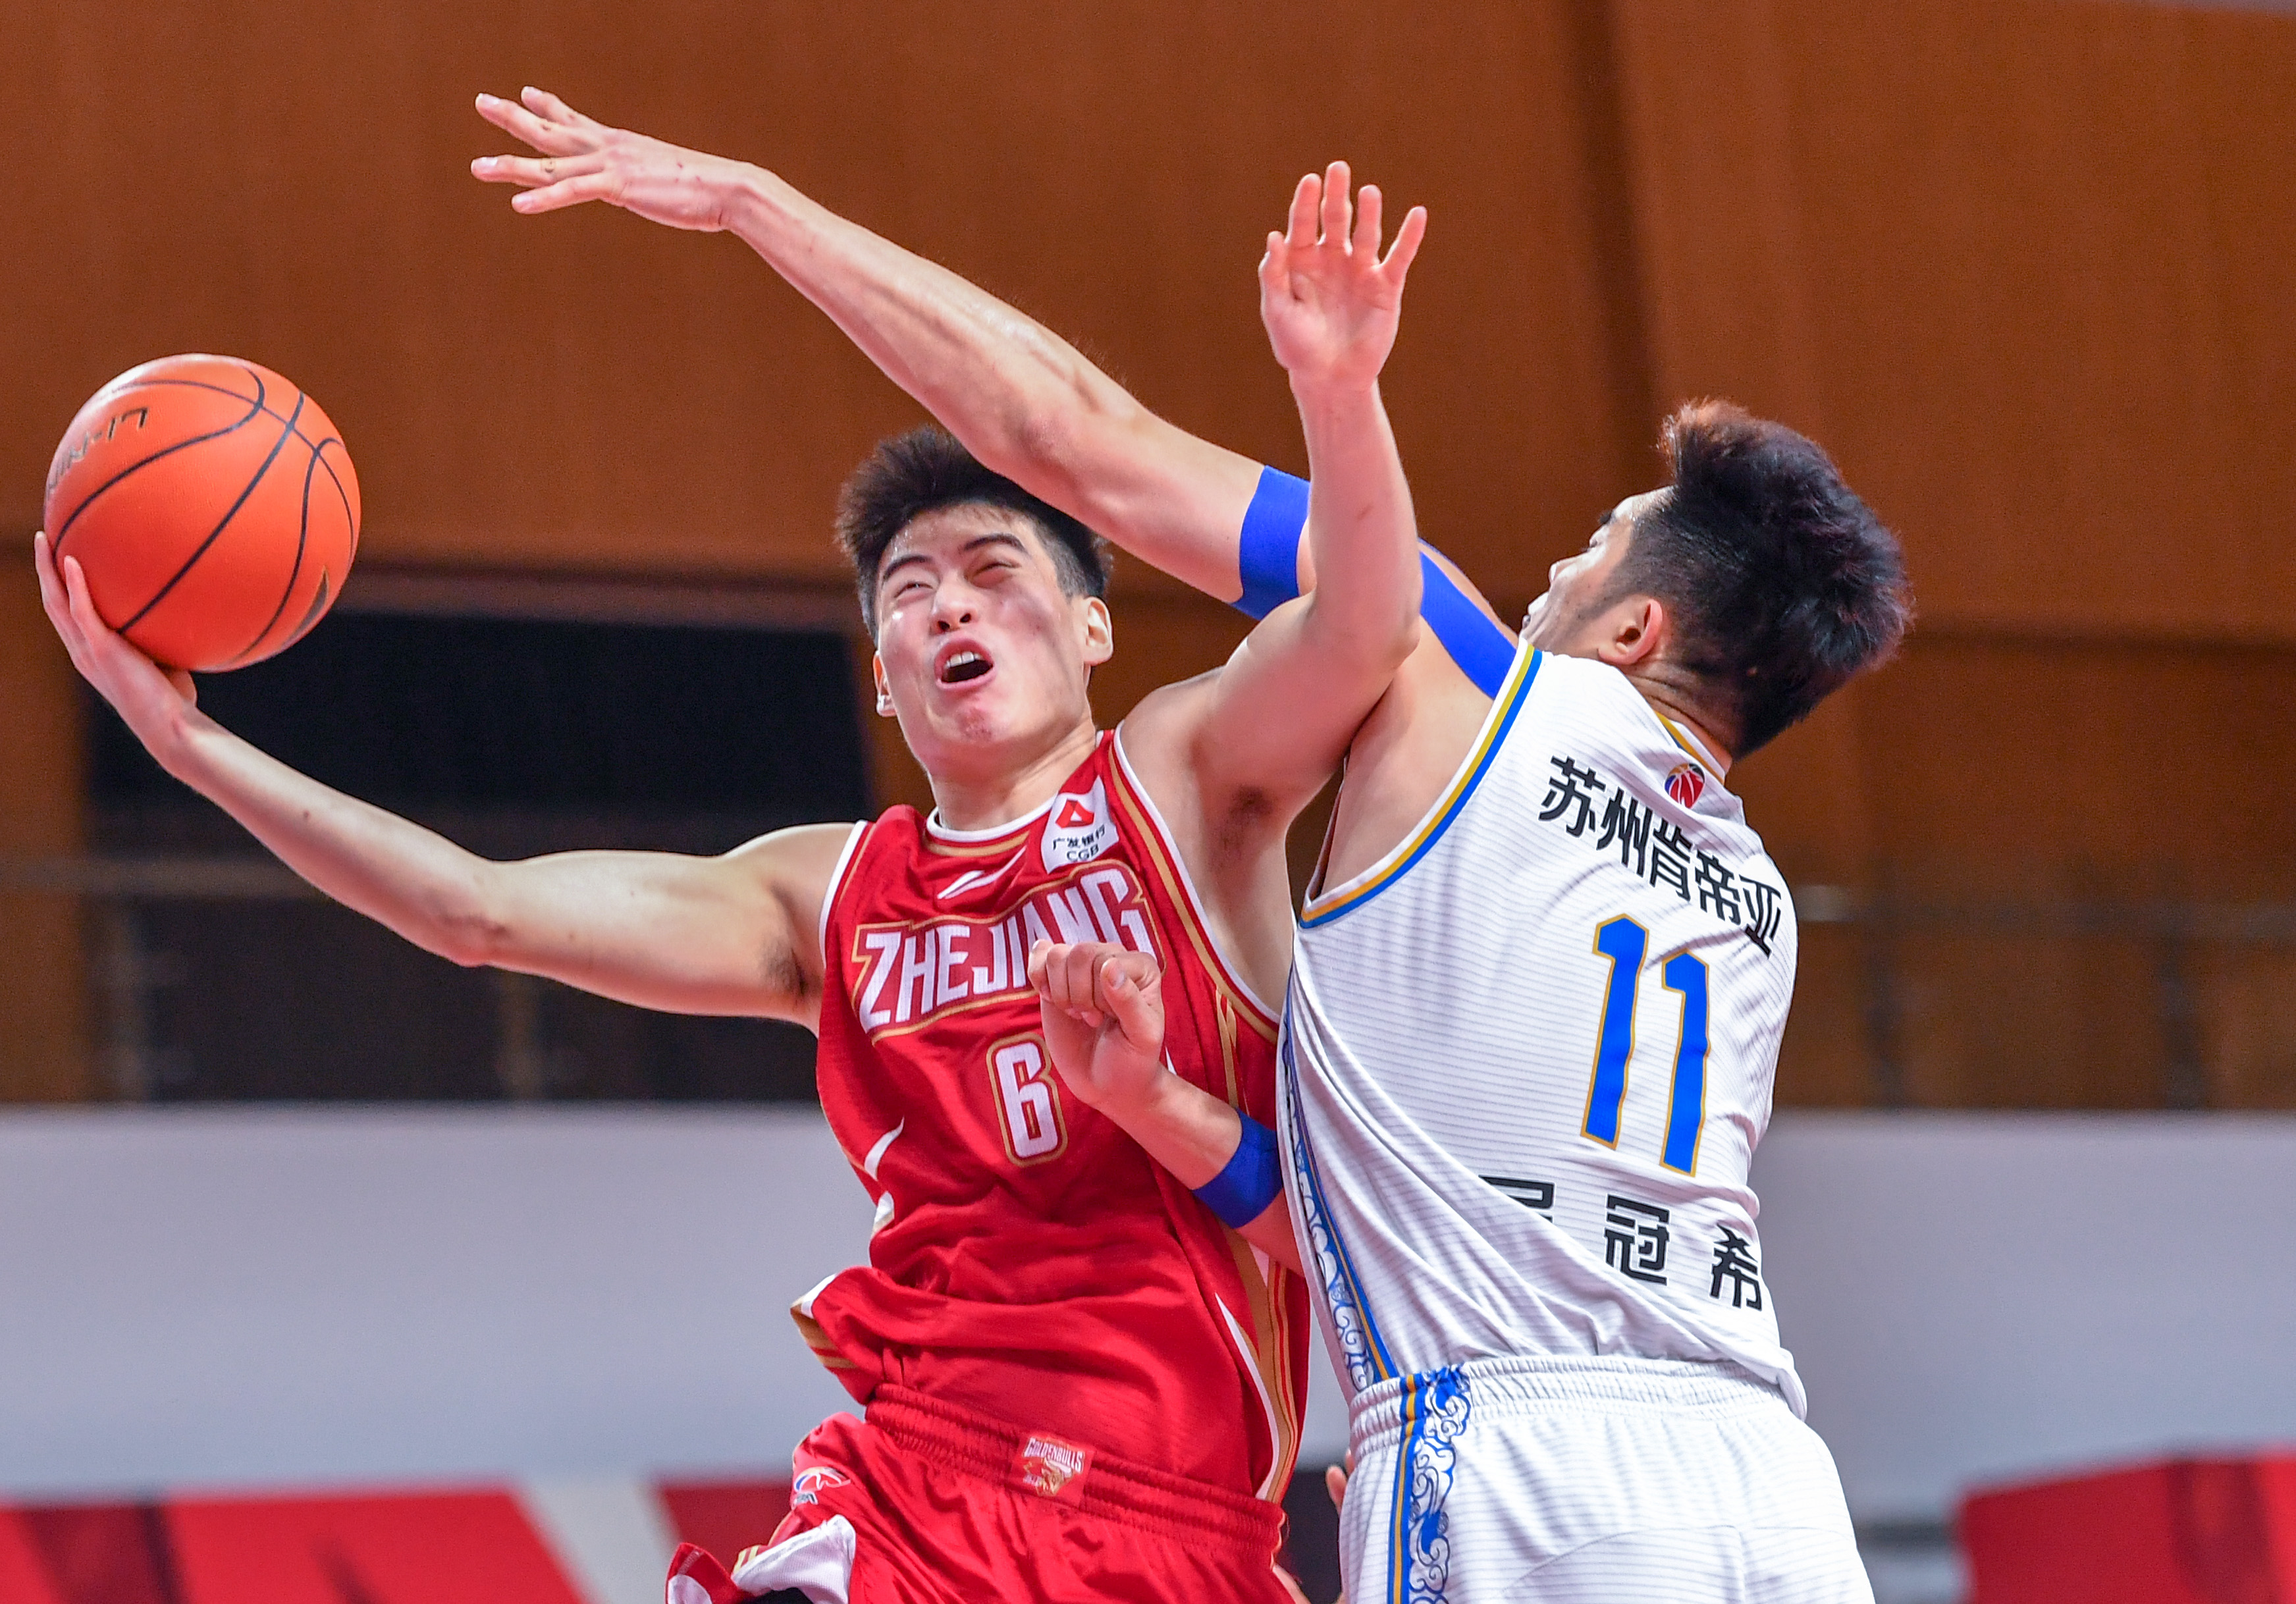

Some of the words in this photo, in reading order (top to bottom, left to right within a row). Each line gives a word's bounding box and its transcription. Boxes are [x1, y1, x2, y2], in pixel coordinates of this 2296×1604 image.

[45, 406, 148, 500] LI-NIN
[1066, 843, 1100, 862] CGB
[1538, 755, 1782, 959] 苏州肯帝亚
[859, 868, 1158, 1029] ZHEJIANG
[990, 1036, 1065, 1164] 6
[1582, 914, 1710, 1177] 11
